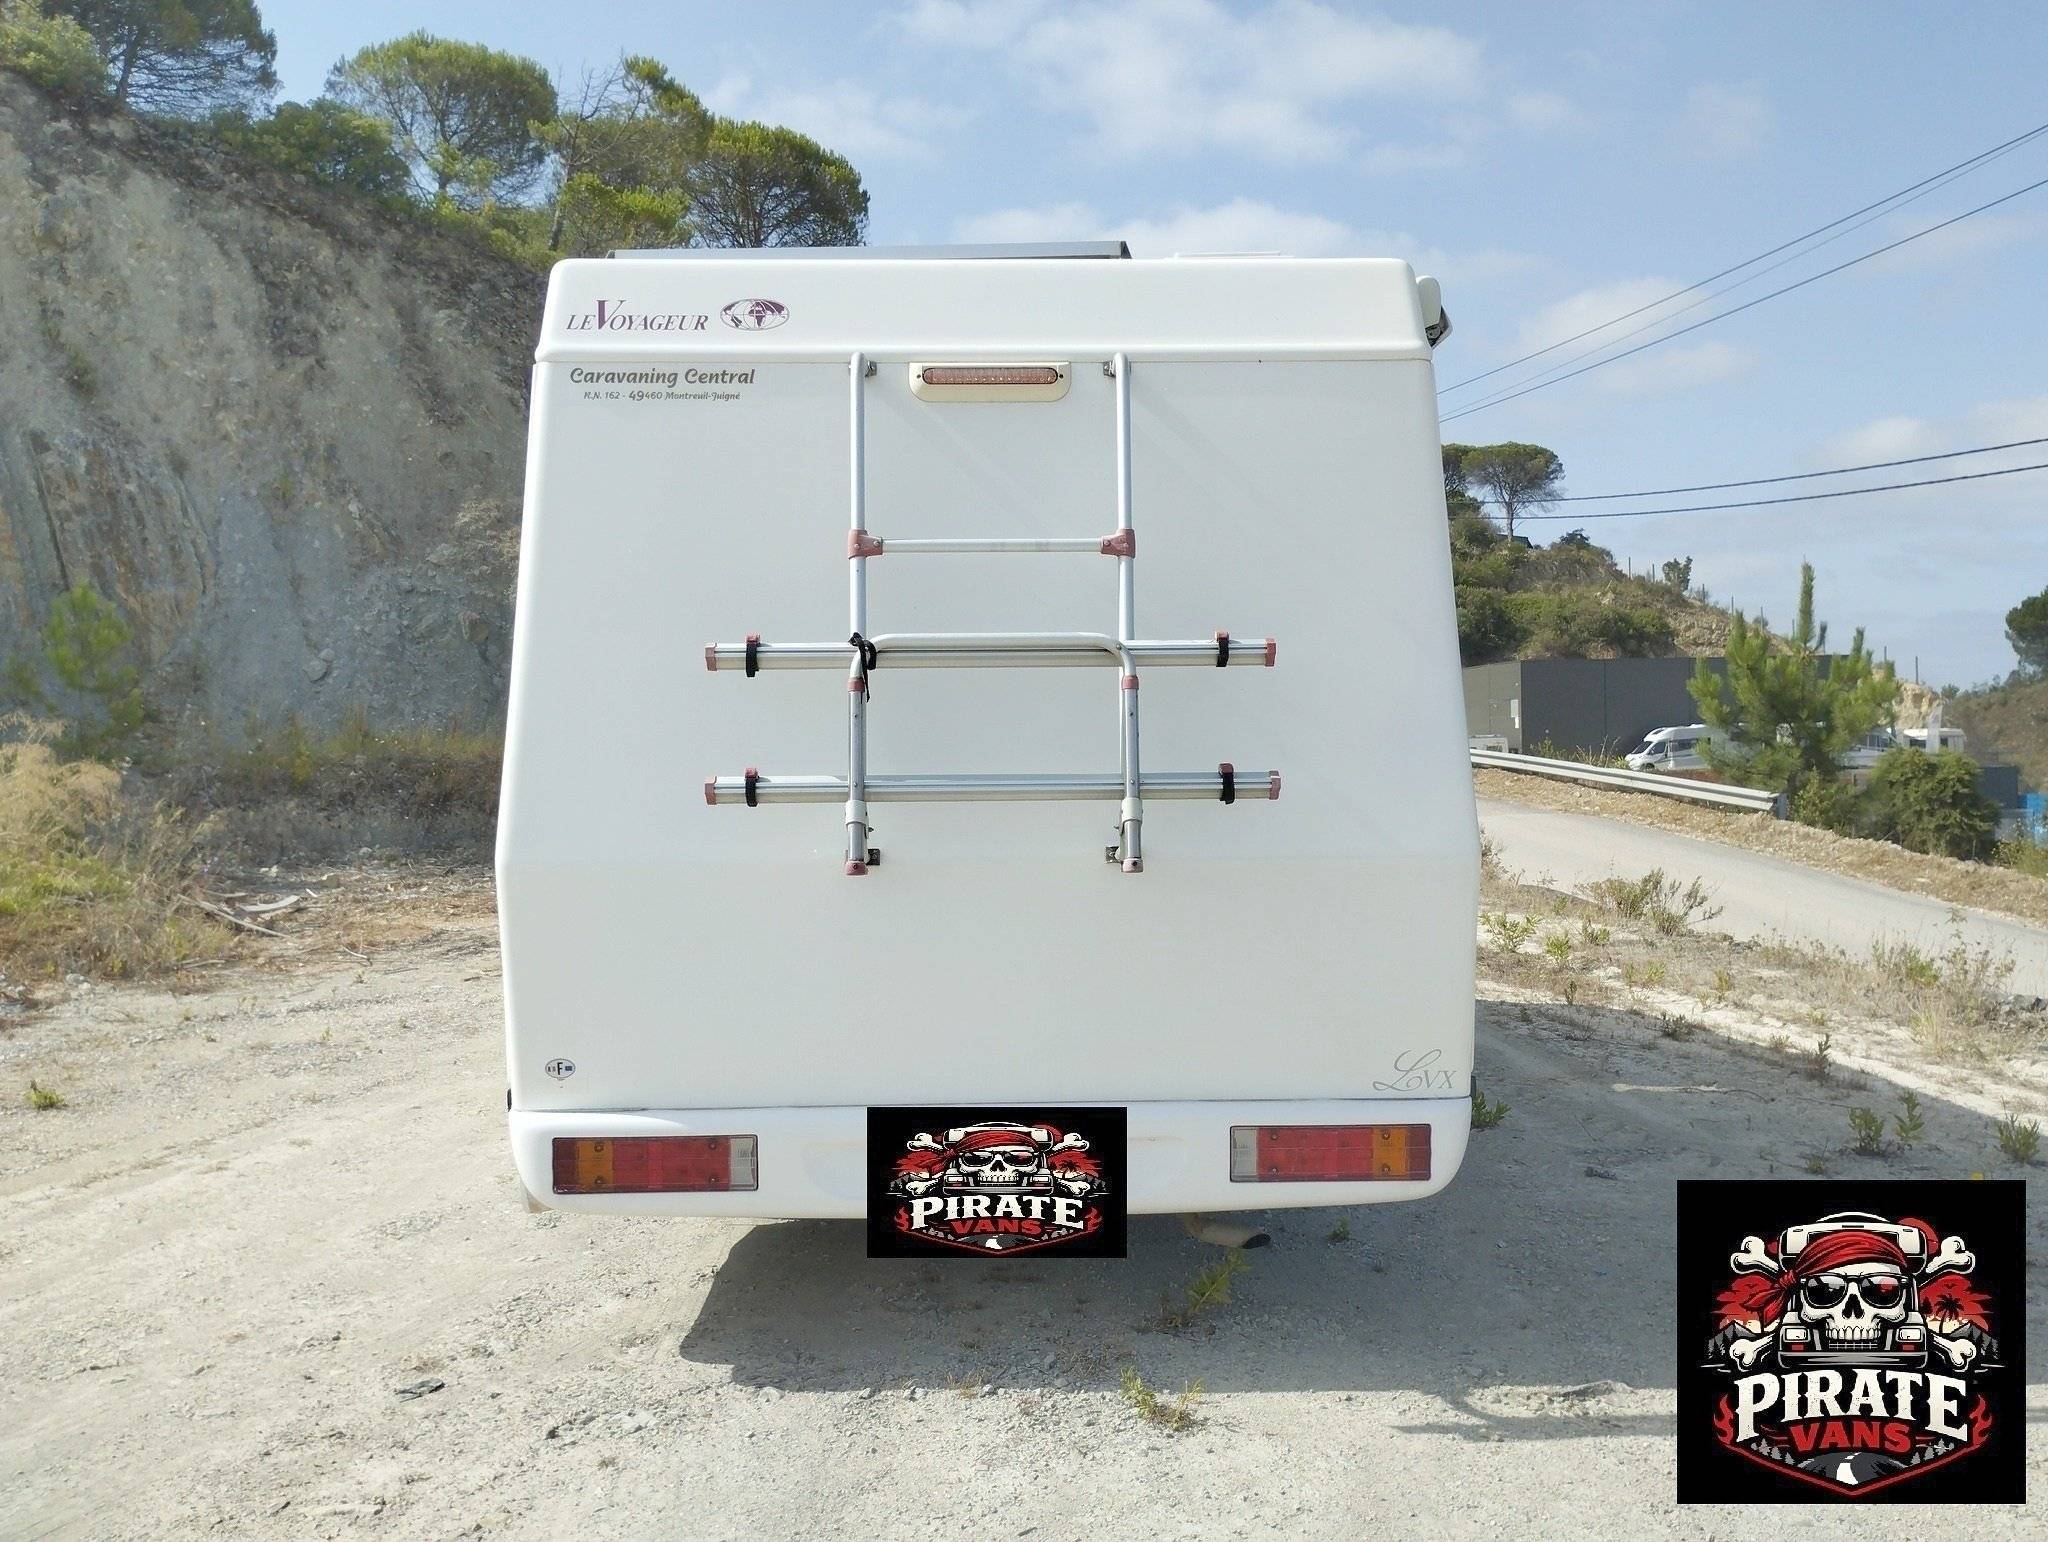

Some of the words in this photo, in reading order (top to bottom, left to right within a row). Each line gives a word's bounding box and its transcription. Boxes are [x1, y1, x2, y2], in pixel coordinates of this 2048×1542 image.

[570, 367, 677, 388] Caravaning
[684, 368, 756, 384] Central
[605, 391, 621, 399] 162
[628, 390, 663, 401] 49460
